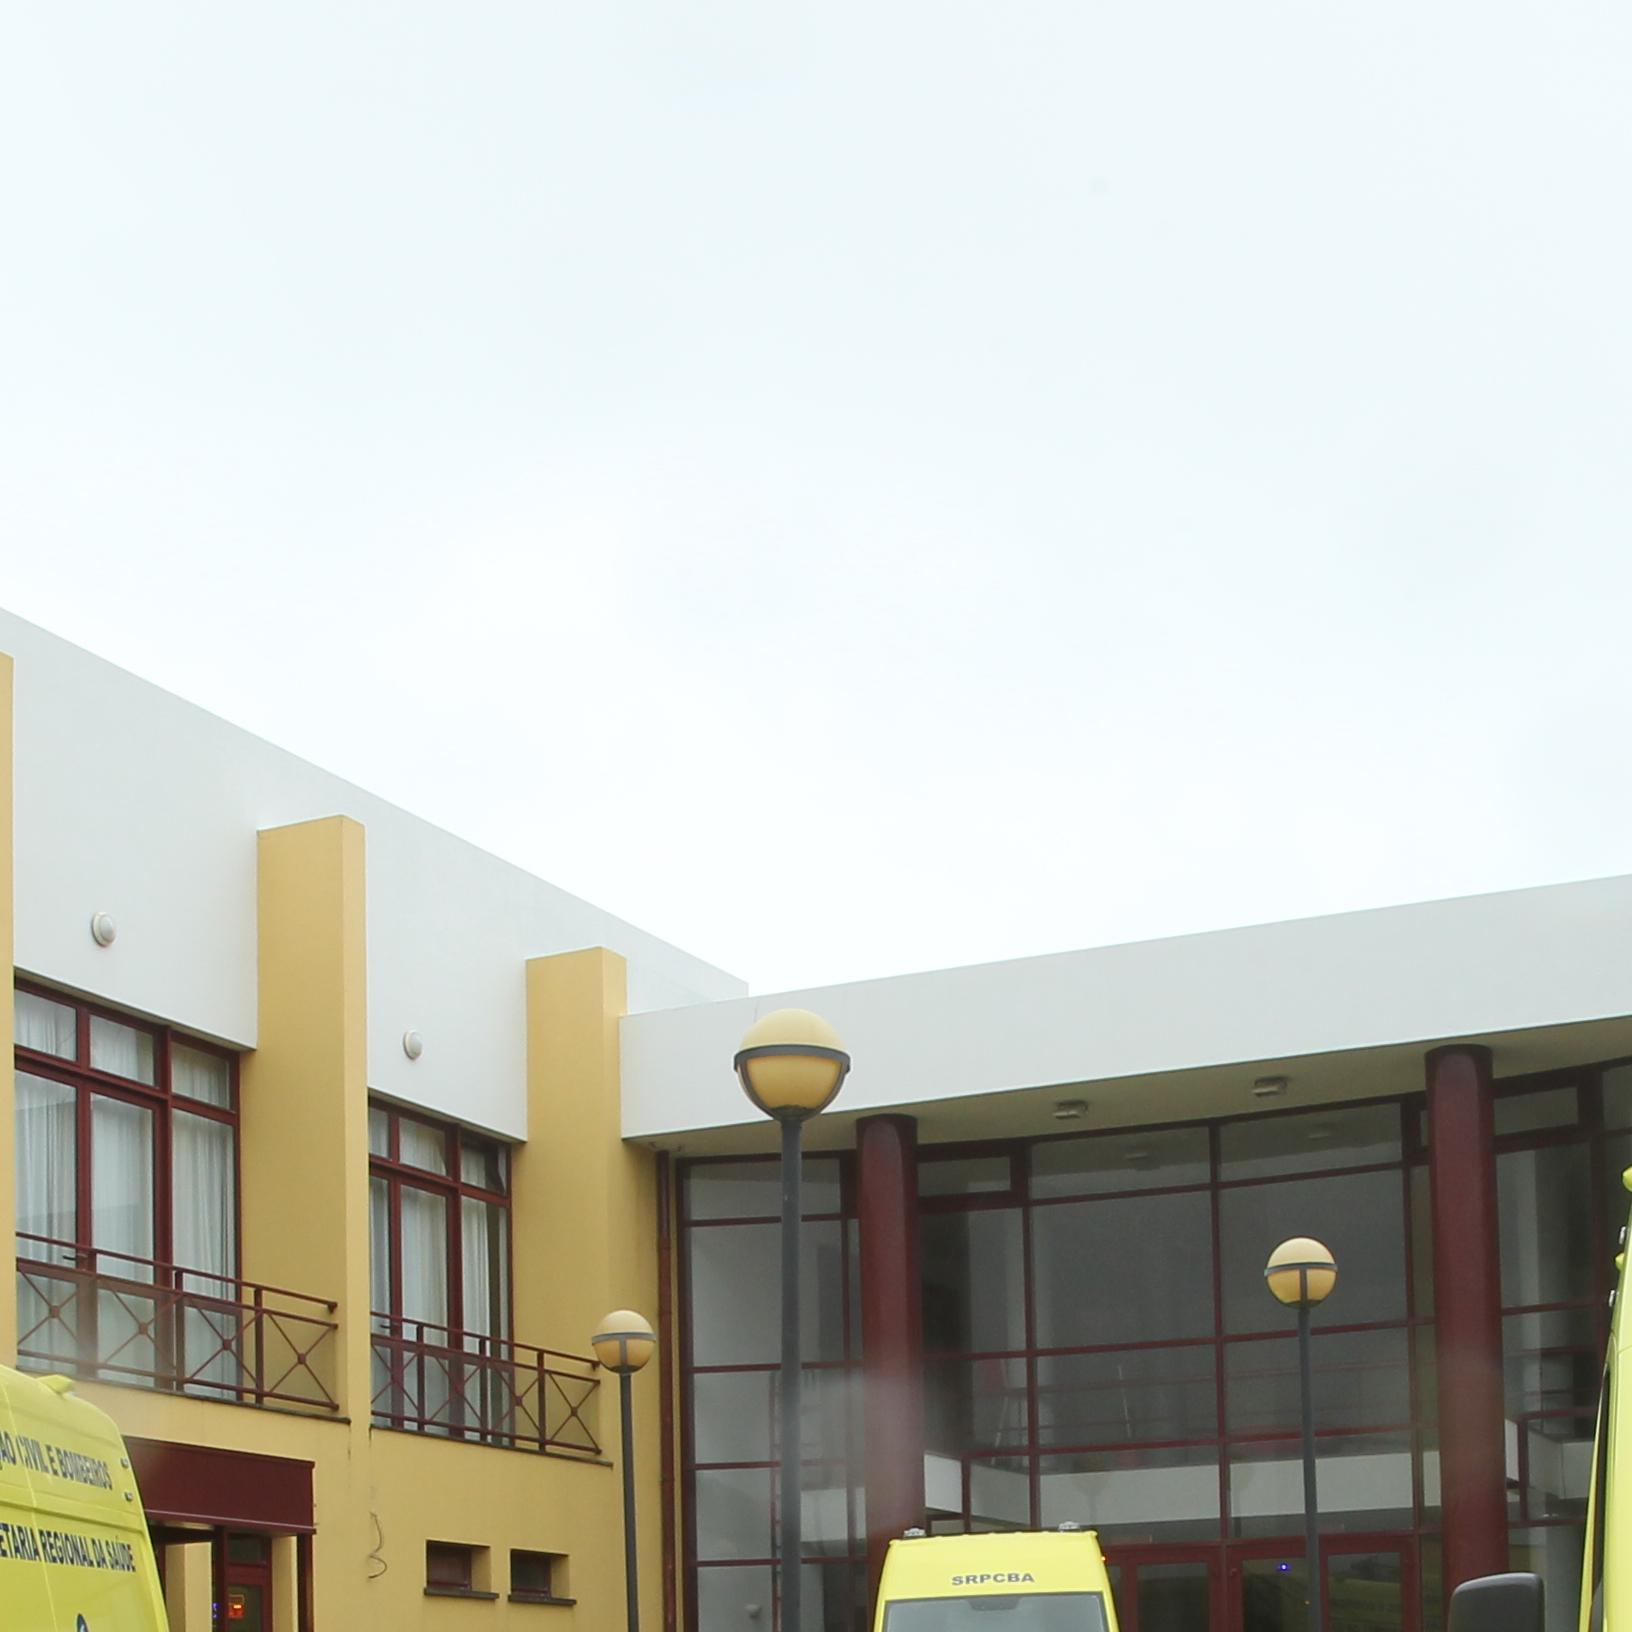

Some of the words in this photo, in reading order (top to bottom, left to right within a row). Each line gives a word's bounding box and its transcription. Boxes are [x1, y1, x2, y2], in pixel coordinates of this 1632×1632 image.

[39, 1529, 94, 1566] REGIONAL
[91, 1537, 109, 1569] DA
[952, 1573, 1035, 1586] SRPCBA
